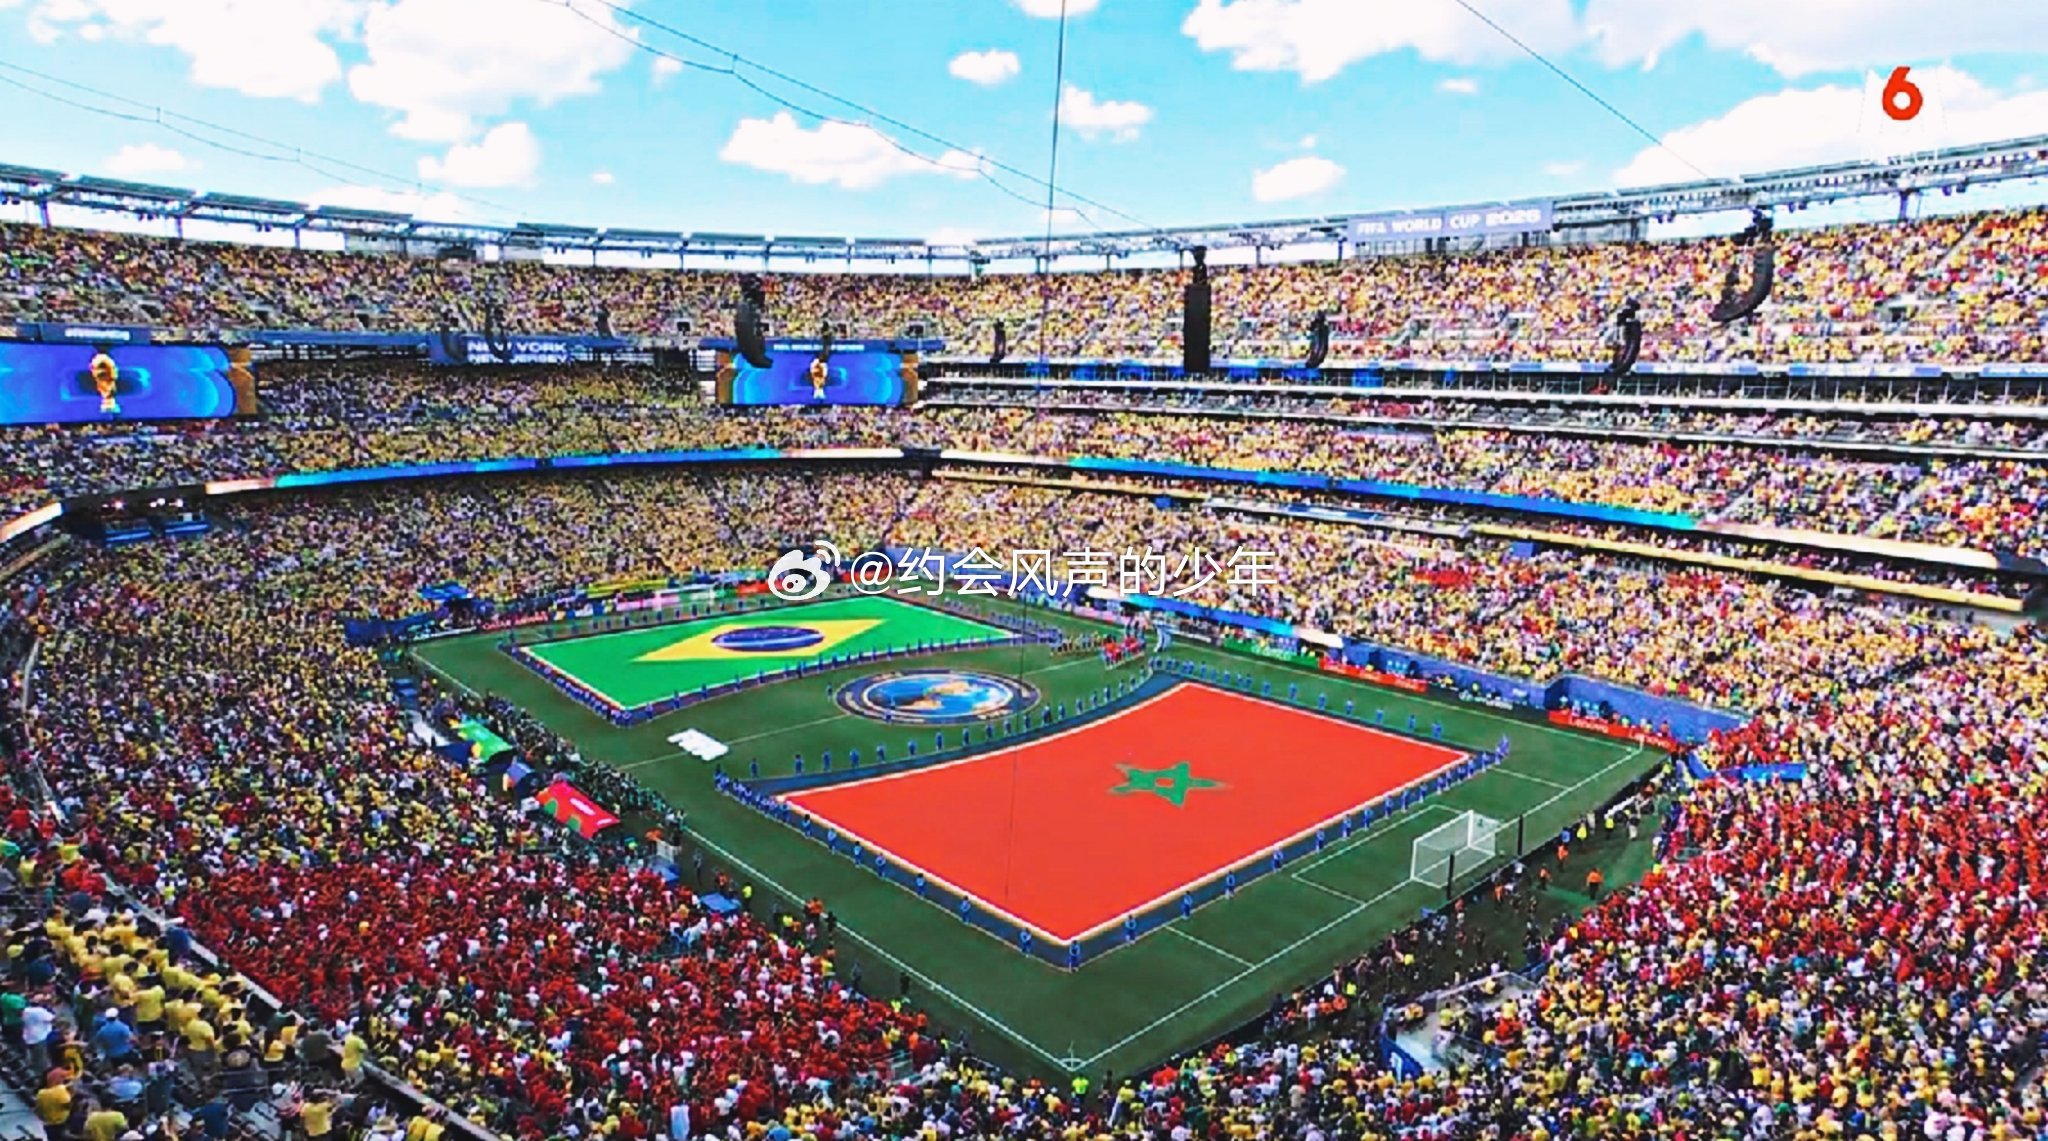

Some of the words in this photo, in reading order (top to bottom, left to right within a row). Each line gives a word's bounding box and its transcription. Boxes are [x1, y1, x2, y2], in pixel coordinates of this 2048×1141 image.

[1357, 221, 1387, 235] FIFA
[1391, 217, 1442, 233] WORLD
[1450, 213, 1481, 228] CUP
[1485, 209, 1541, 226] 2026
[516, 341, 566, 352] YORK
[509, 353, 568, 364] JERSEY
